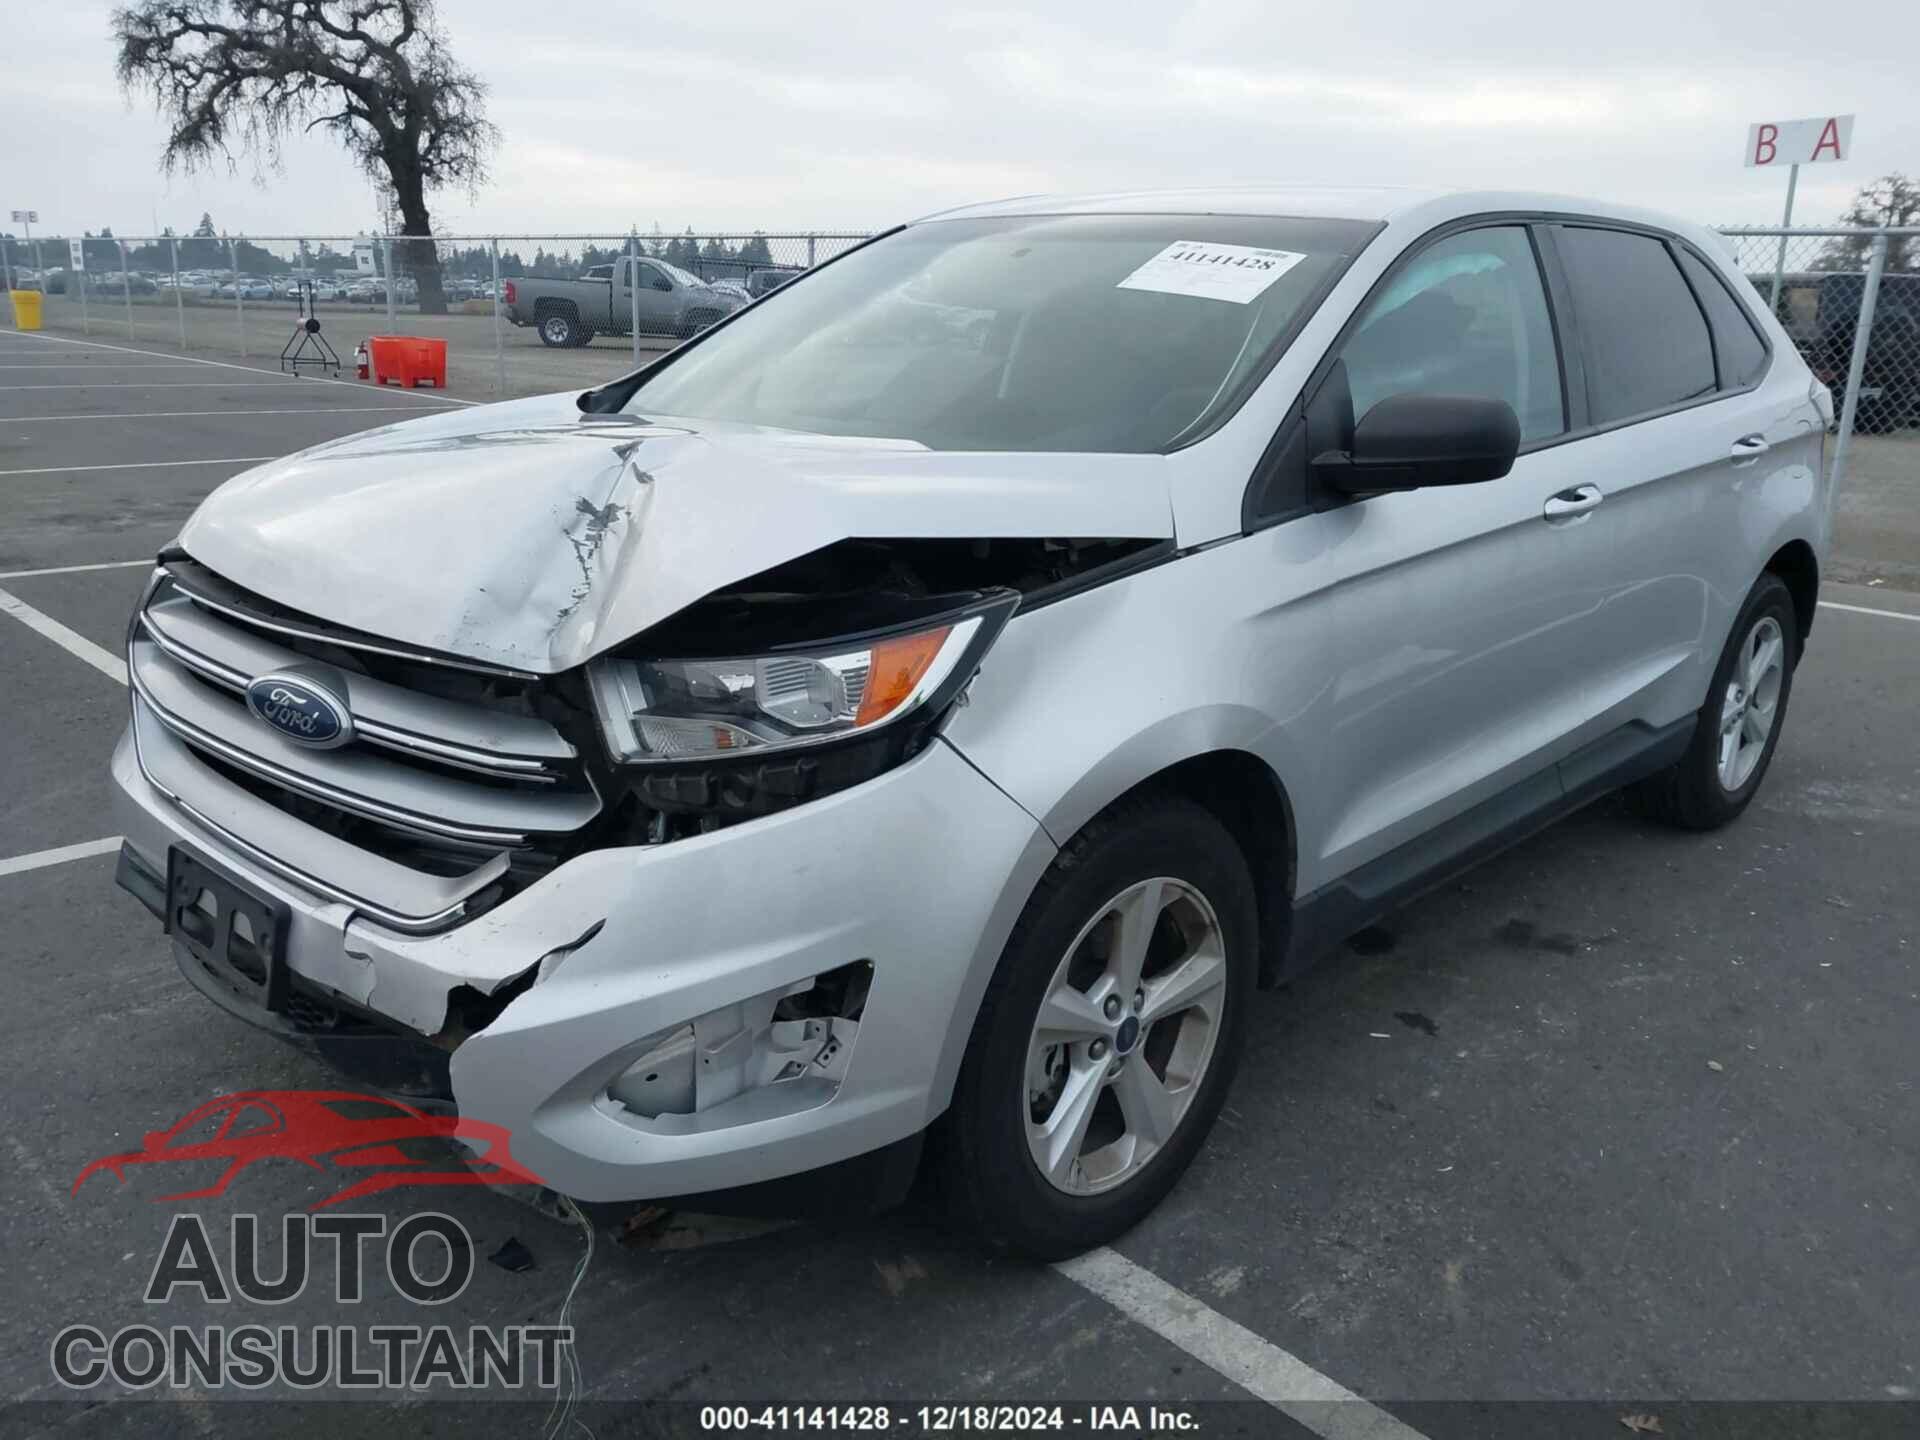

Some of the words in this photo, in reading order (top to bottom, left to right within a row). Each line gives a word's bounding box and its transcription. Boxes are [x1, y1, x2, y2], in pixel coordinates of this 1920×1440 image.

[1754, 124, 1778, 165] B
[1810, 118, 1840, 162] A
[1168, 251, 1276, 270] 41141428
[264, 688, 320, 733] Ford
